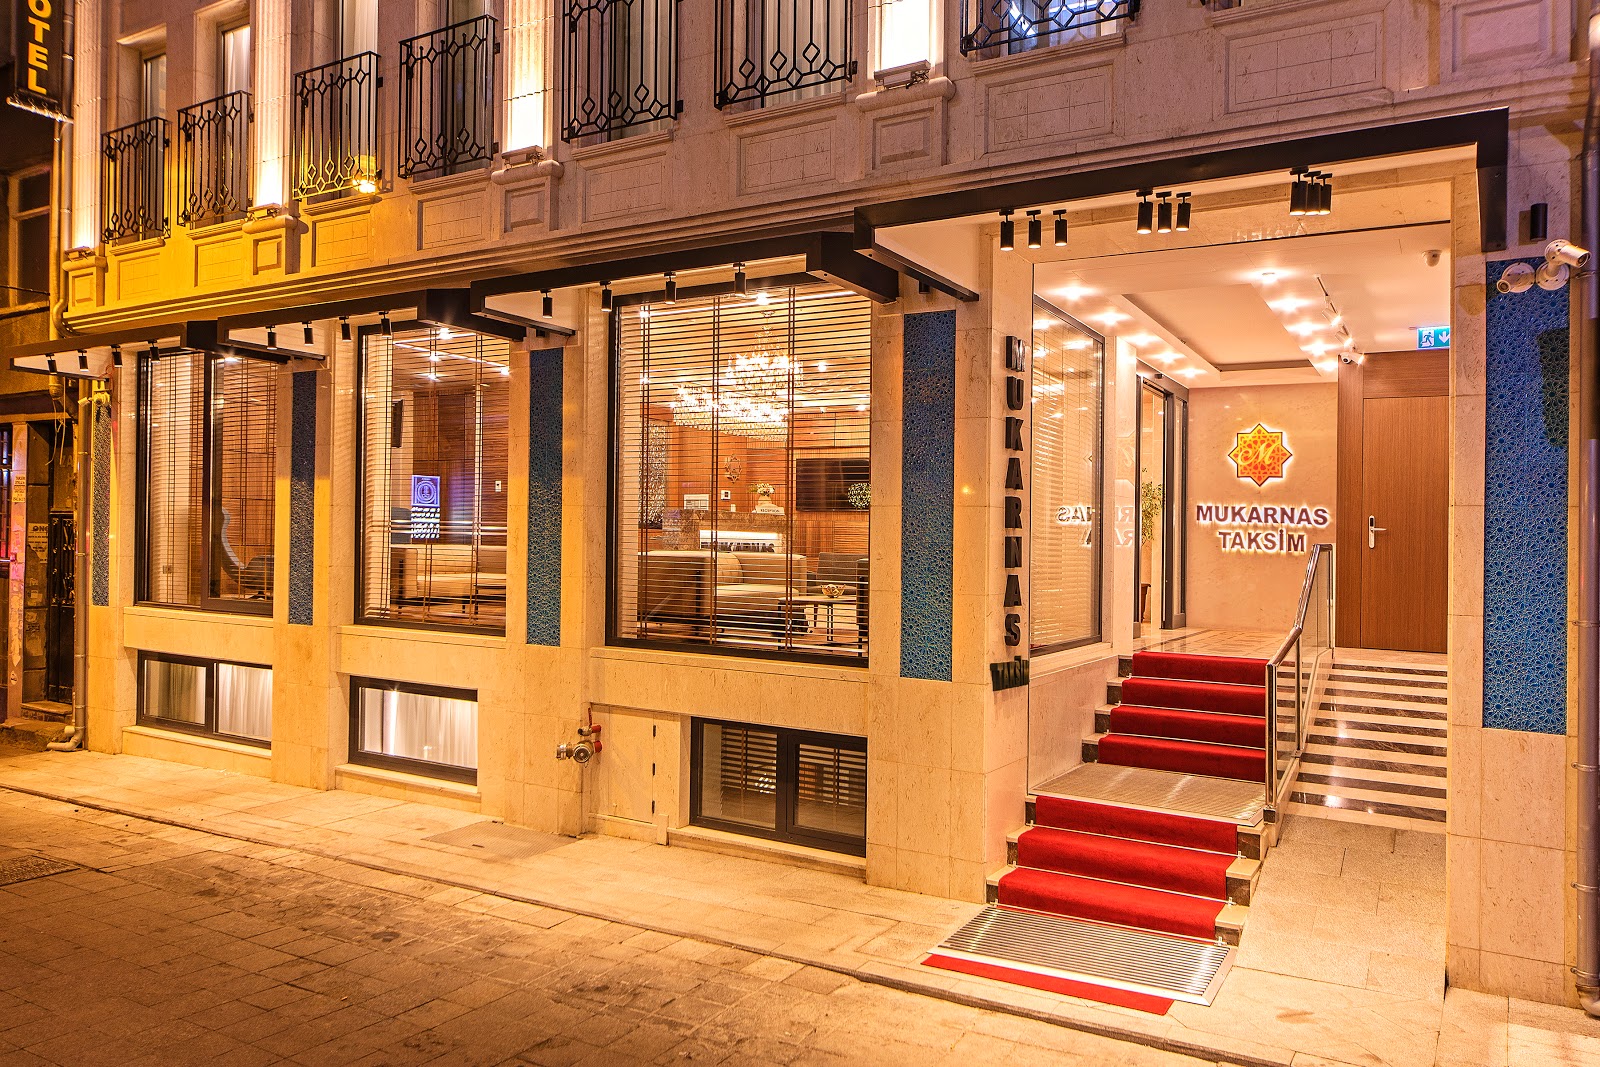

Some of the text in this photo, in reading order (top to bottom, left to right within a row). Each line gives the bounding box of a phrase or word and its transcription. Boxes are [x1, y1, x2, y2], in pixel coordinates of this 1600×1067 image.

[1003, 335, 1026, 647] MUKARNAS
[1196, 504, 1328, 526] MUKARNAS
[1217, 528, 1306, 552] TAKSİM
